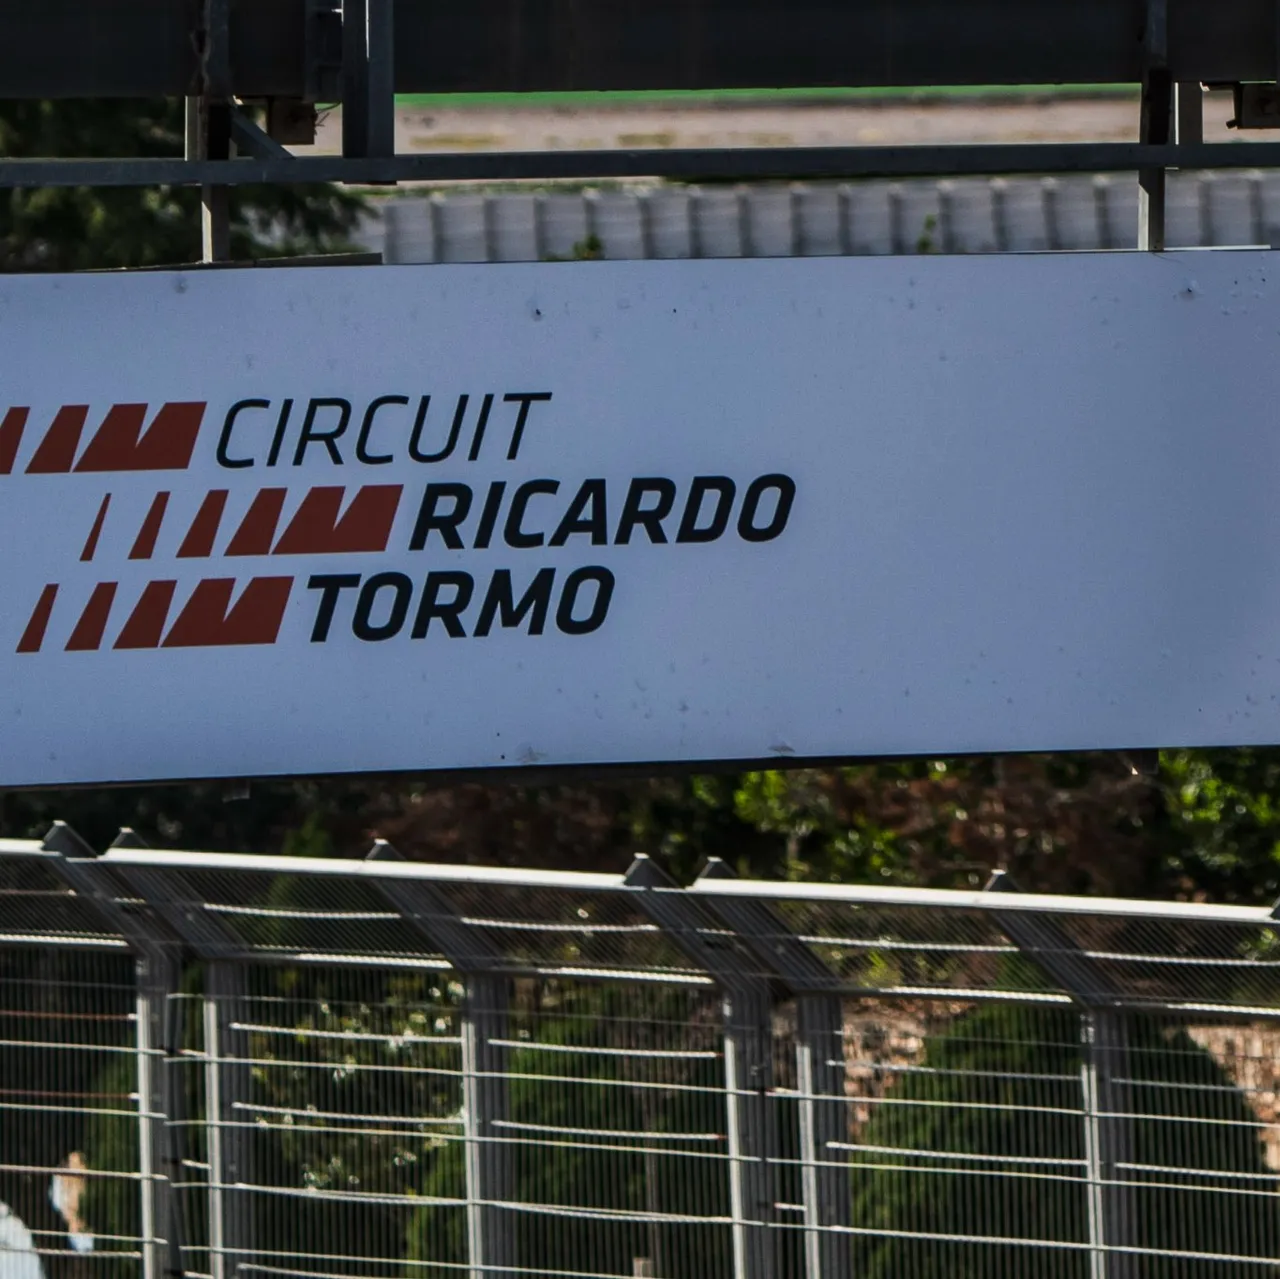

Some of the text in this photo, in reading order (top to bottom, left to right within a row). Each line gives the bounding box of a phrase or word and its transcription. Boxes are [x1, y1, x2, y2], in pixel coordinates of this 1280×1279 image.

[215, 392, 552, 469] CIRCUIT
[409, 473, 796, 551] RICARDO
[307, 566, 615, 643] TORMO
